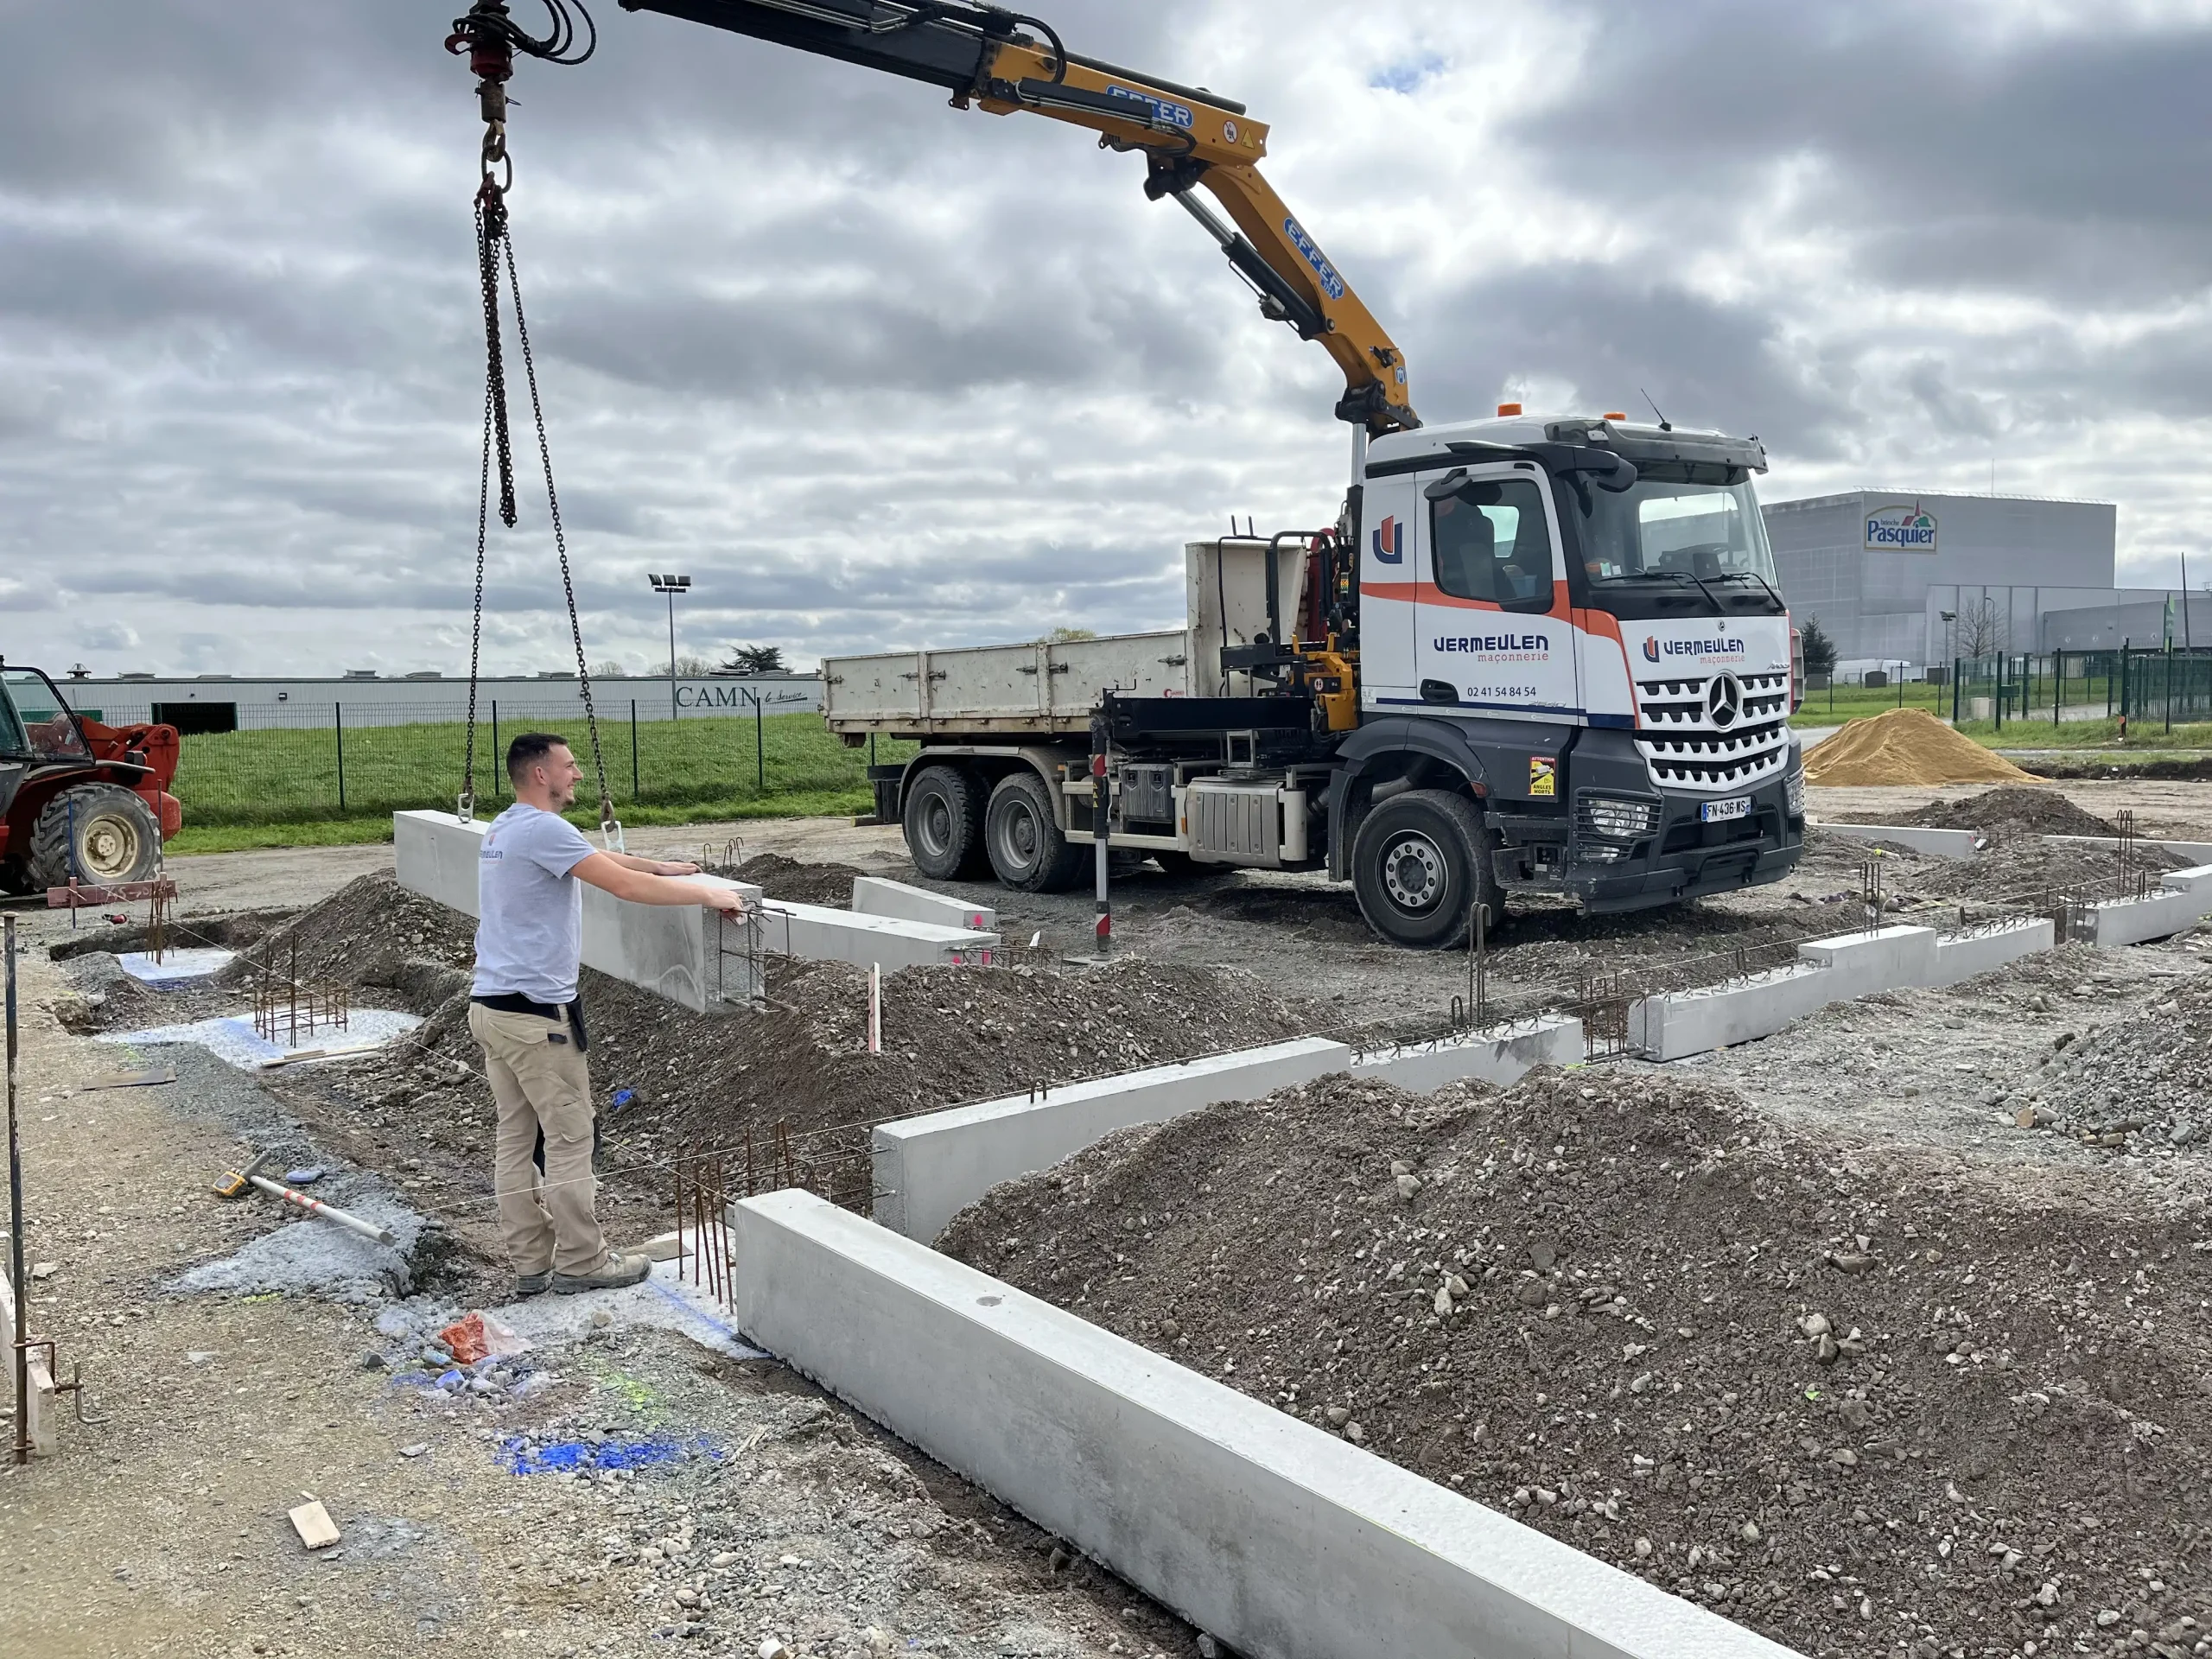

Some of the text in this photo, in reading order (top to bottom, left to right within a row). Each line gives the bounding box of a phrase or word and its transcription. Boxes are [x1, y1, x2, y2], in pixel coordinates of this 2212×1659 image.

[1287, 223, 1341, 295] EFFER
[1867, 520, 1935, 547] Pasquier
[1433, 633, 1548, 653] VERMEULEN
[1663, 638, 1745, 656] VERMEULEN
[1478, 651, 1548, 664] maçonnerie
[1700, 654, 1745, 665] maçonnerie
[676, 686, 758, 708] CAMN
[1467, 686, 1536, 697] 02 41 54 84 54
